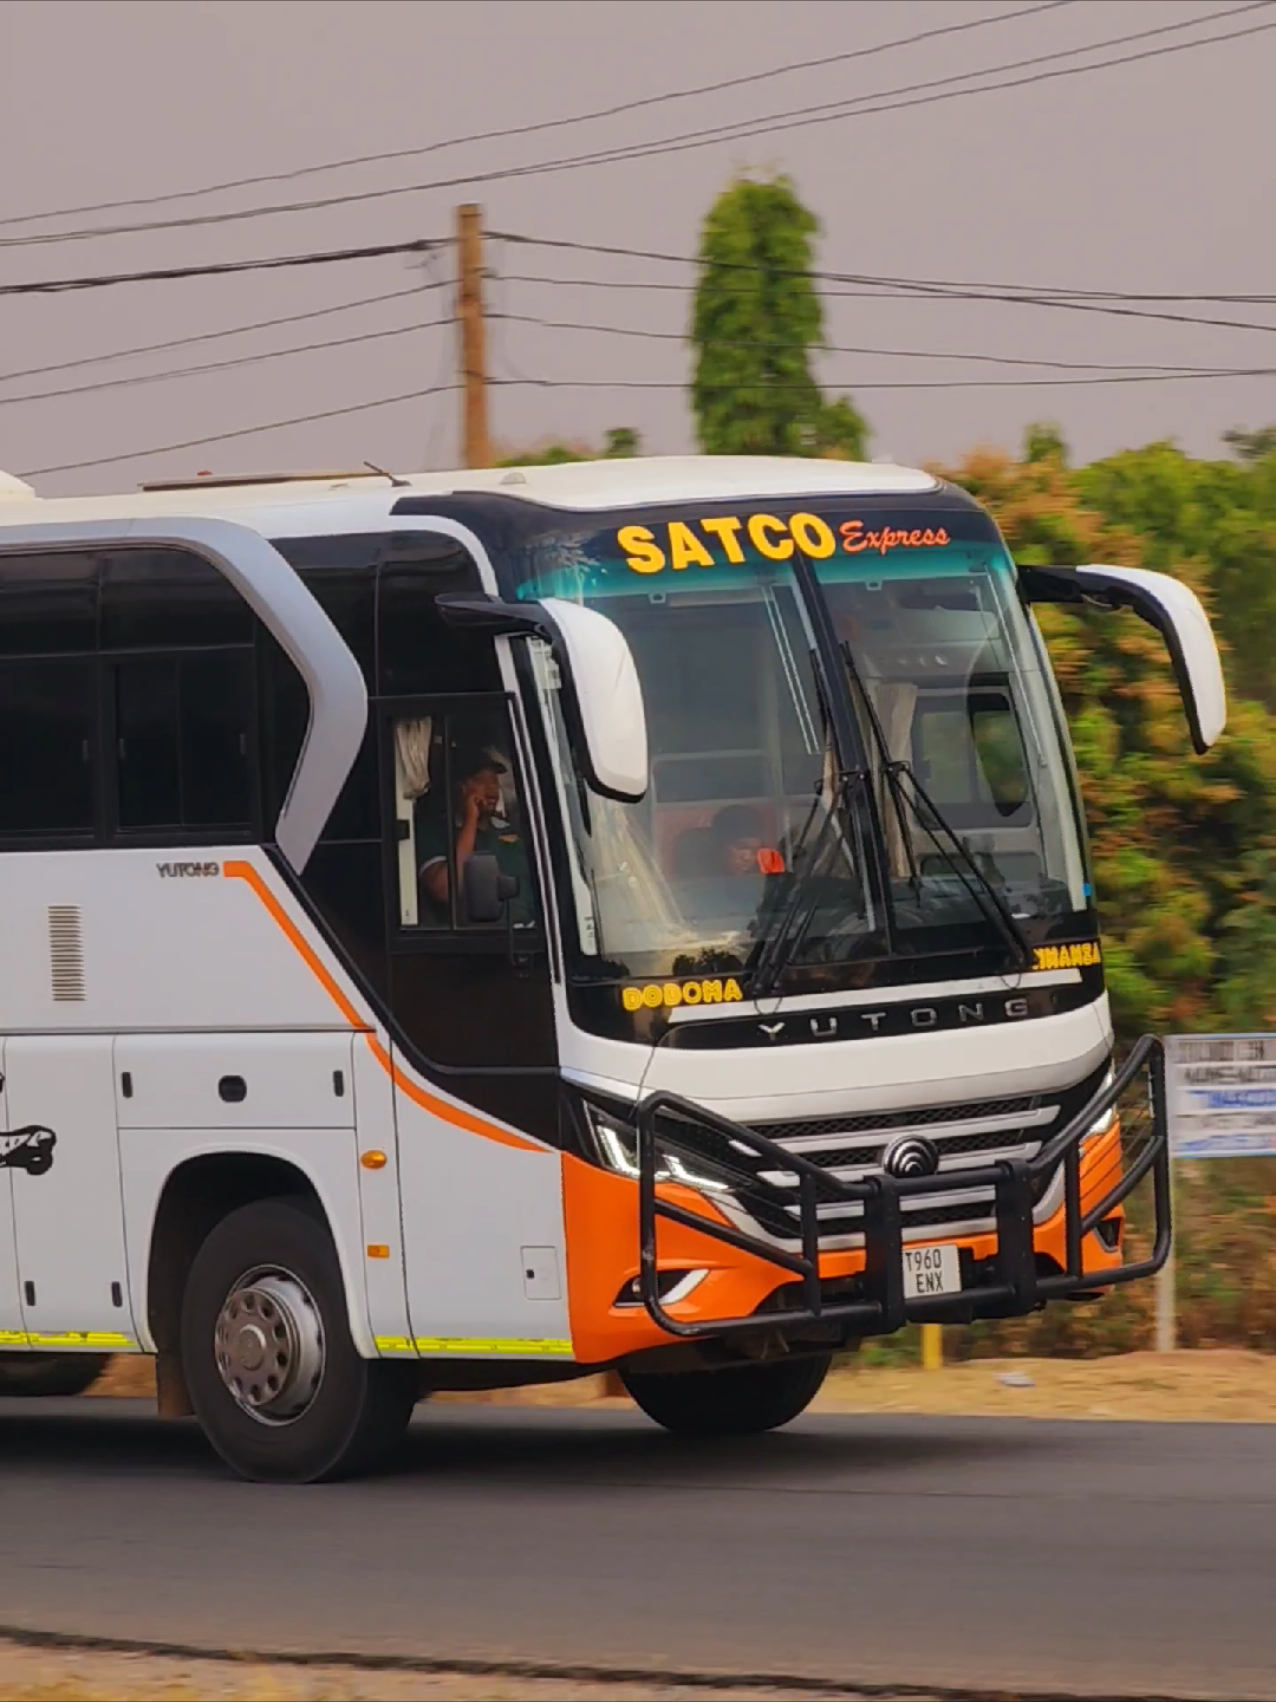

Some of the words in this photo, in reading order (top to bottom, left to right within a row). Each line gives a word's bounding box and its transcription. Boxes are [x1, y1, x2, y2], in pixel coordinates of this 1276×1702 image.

[617, 512, 836, 574] SATCO
[839, 520, 951, 555] Express
[156, 861, 219, 878] YUTONG
[622, 978, 743, 1011] DODOMA
[758, 998, 1028, 1041] YUTONG
[905, 1248, 942, 1272] T960
[915, 1269, 943, 1294] ENX
